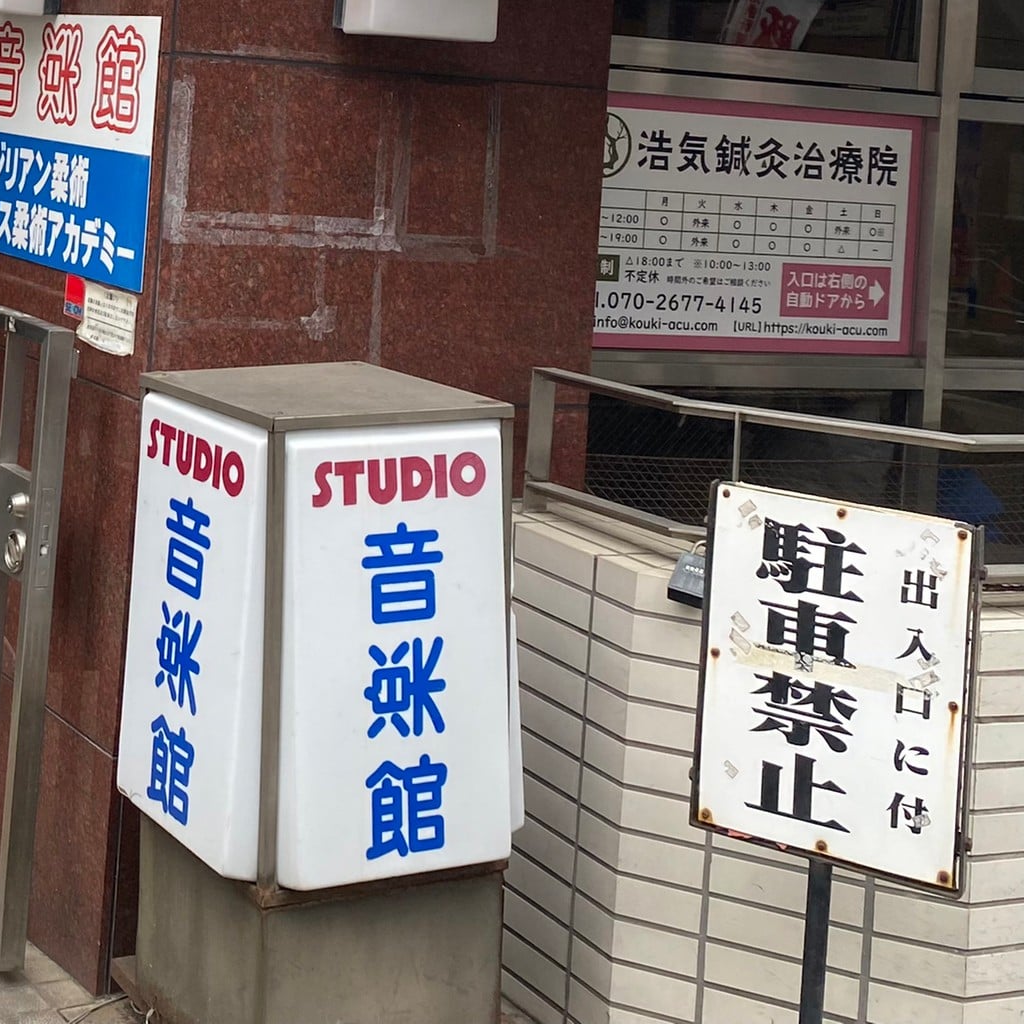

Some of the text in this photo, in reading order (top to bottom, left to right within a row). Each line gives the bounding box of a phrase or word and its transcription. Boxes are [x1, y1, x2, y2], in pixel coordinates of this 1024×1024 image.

[637, 130, 898, 187] 浩気鍼灸治療院
[661, 196, 881, 219] 月 火 水 木 金 土 日
[625, 270, 660, 284] 不定休
[786, 271, 868, 290] 入口は右側の
[786, 291, 866, 310] 自動ドアから
[147, 418, 245, 498] STUDIO
[312, 451, 487, 508] STUDIO
[744, 516, 868, 834] 駐車禁止
[886, 569, 939, 835] 出入口に付
